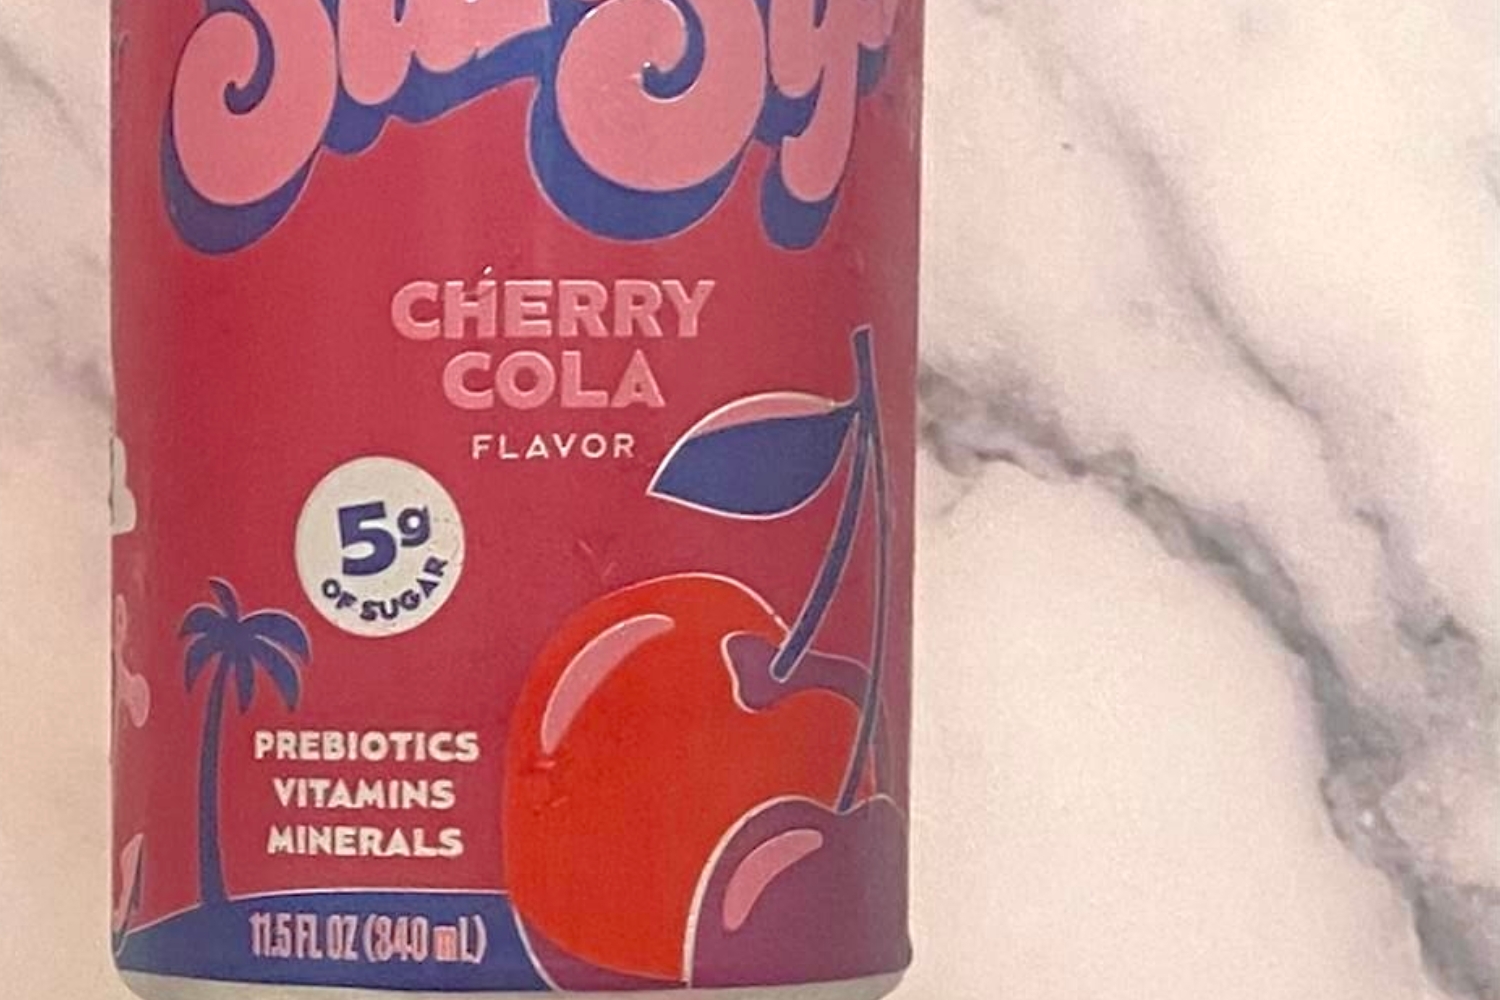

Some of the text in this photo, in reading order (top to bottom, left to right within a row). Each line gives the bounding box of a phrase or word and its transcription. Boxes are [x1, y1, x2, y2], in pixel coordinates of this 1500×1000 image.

[391, 279, 716, 340] CHERRY
[442, 349, 665, 410] COLA
[472, 433, 635, 459] FLAVOR
[337, 501, 431, 577] 5g
[321, 556, 448, 621] OF SUGAR
[254, 730, 480, 762] PREBIOTICS
[273, 778, 456, 809] VITAMINS
[267, 825, 465, 857] MINERALS
[296, 913, 323, 959] FL
[326, 914, 359, 960] OZ
